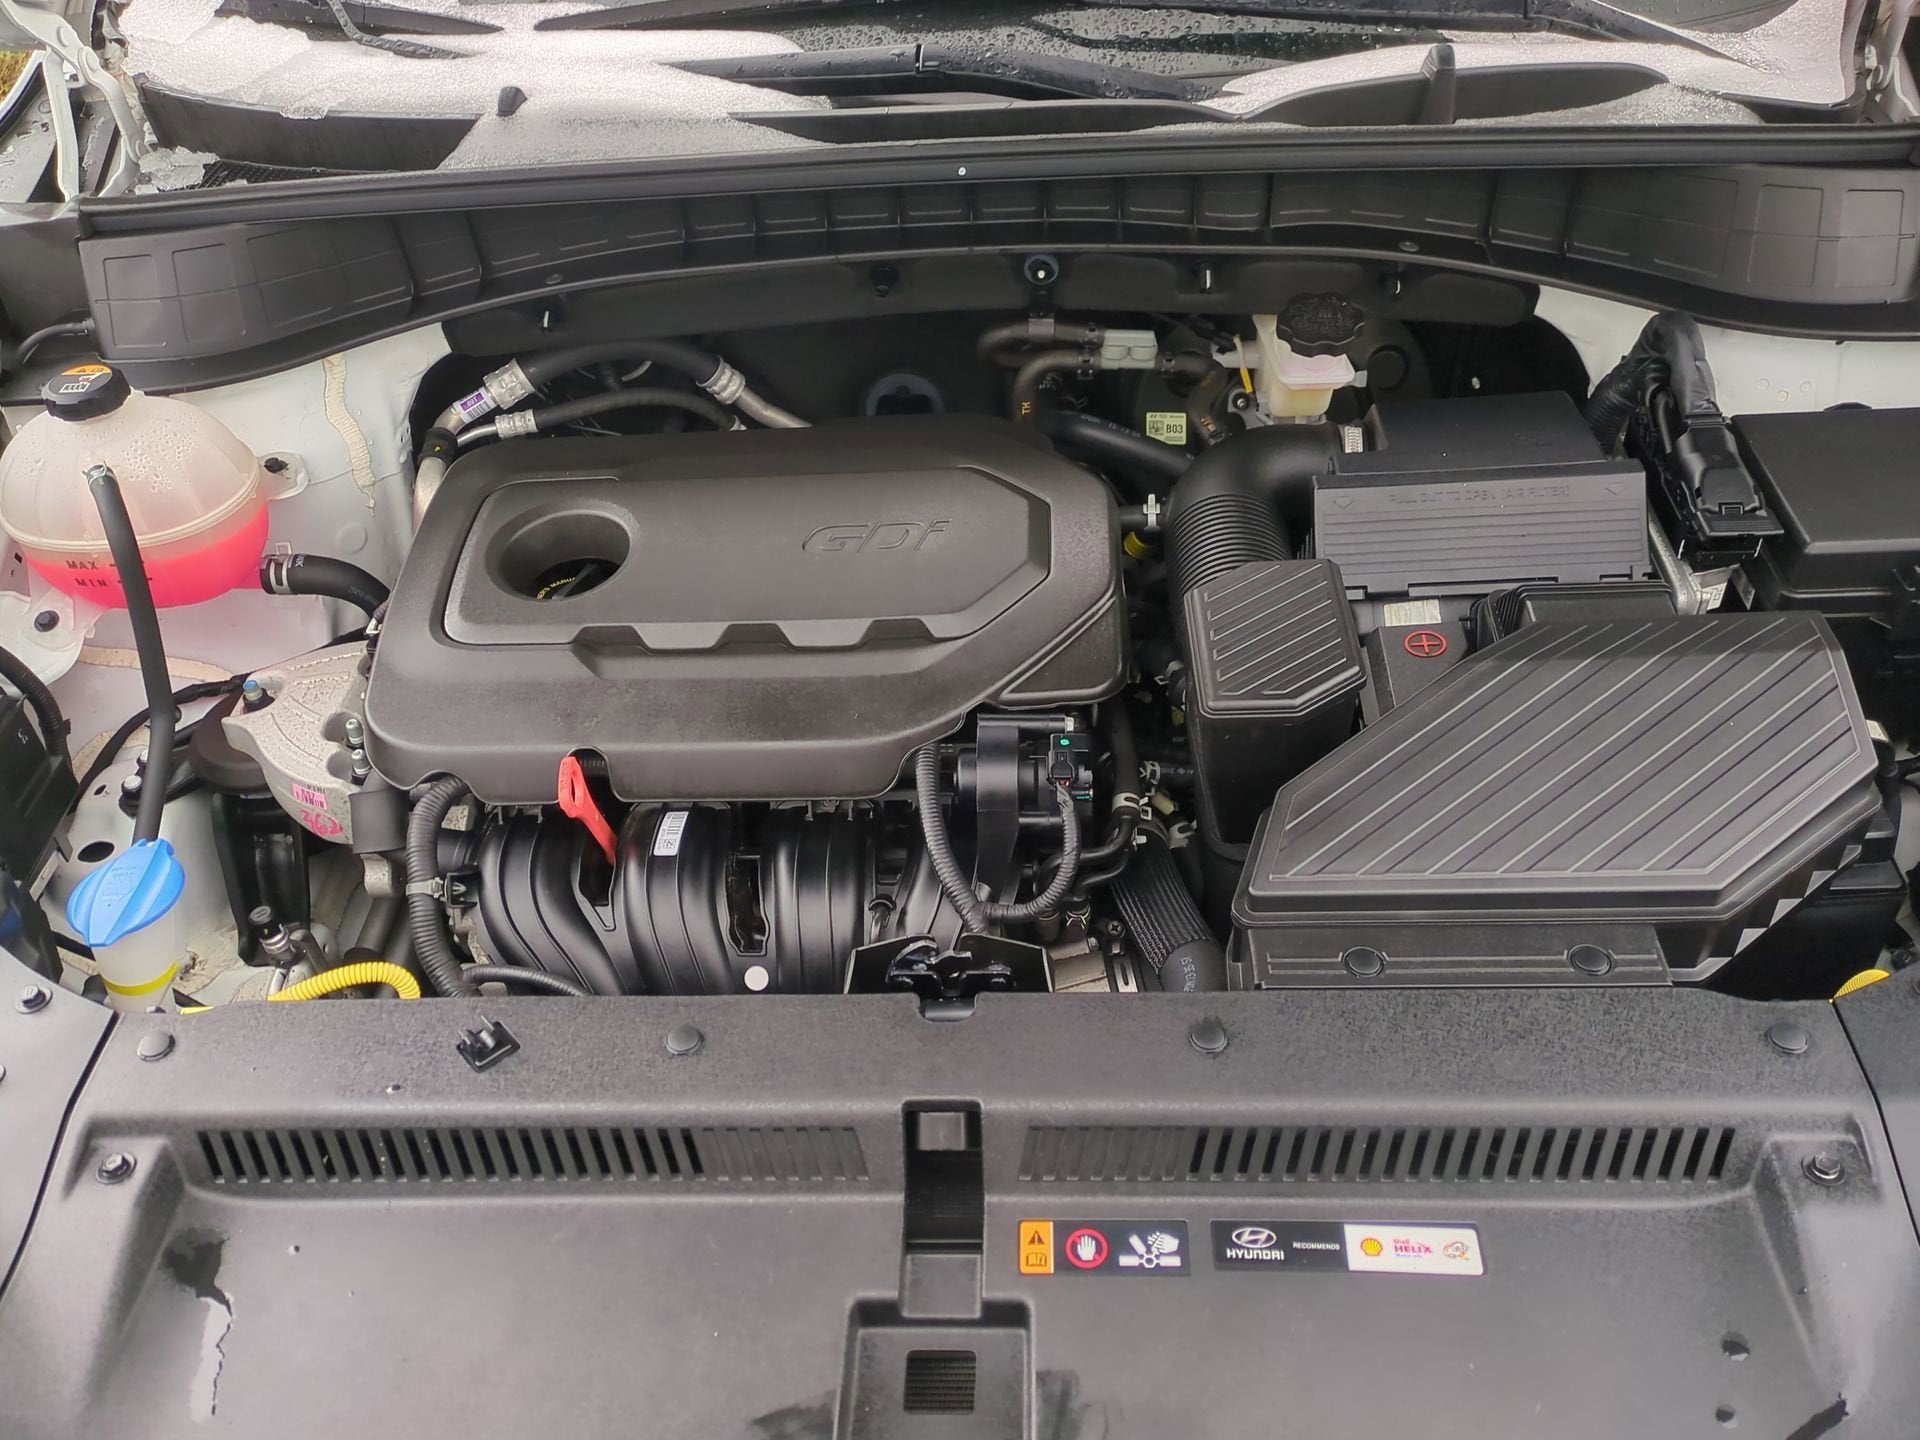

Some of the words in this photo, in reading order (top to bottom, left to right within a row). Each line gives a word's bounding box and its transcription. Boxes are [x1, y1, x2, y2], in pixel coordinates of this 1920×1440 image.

[1166, 424, 1184, 434] B03
[66, 560, 98, 570] MAX
[74, 577, 108, 588] MIN
[1292, 1241, 1341, 1251] RECOMMENDS
[1393, 1243, 1434, 1255] HELIX
[1226, 1248, 1285, 1261] HYUNDAI
